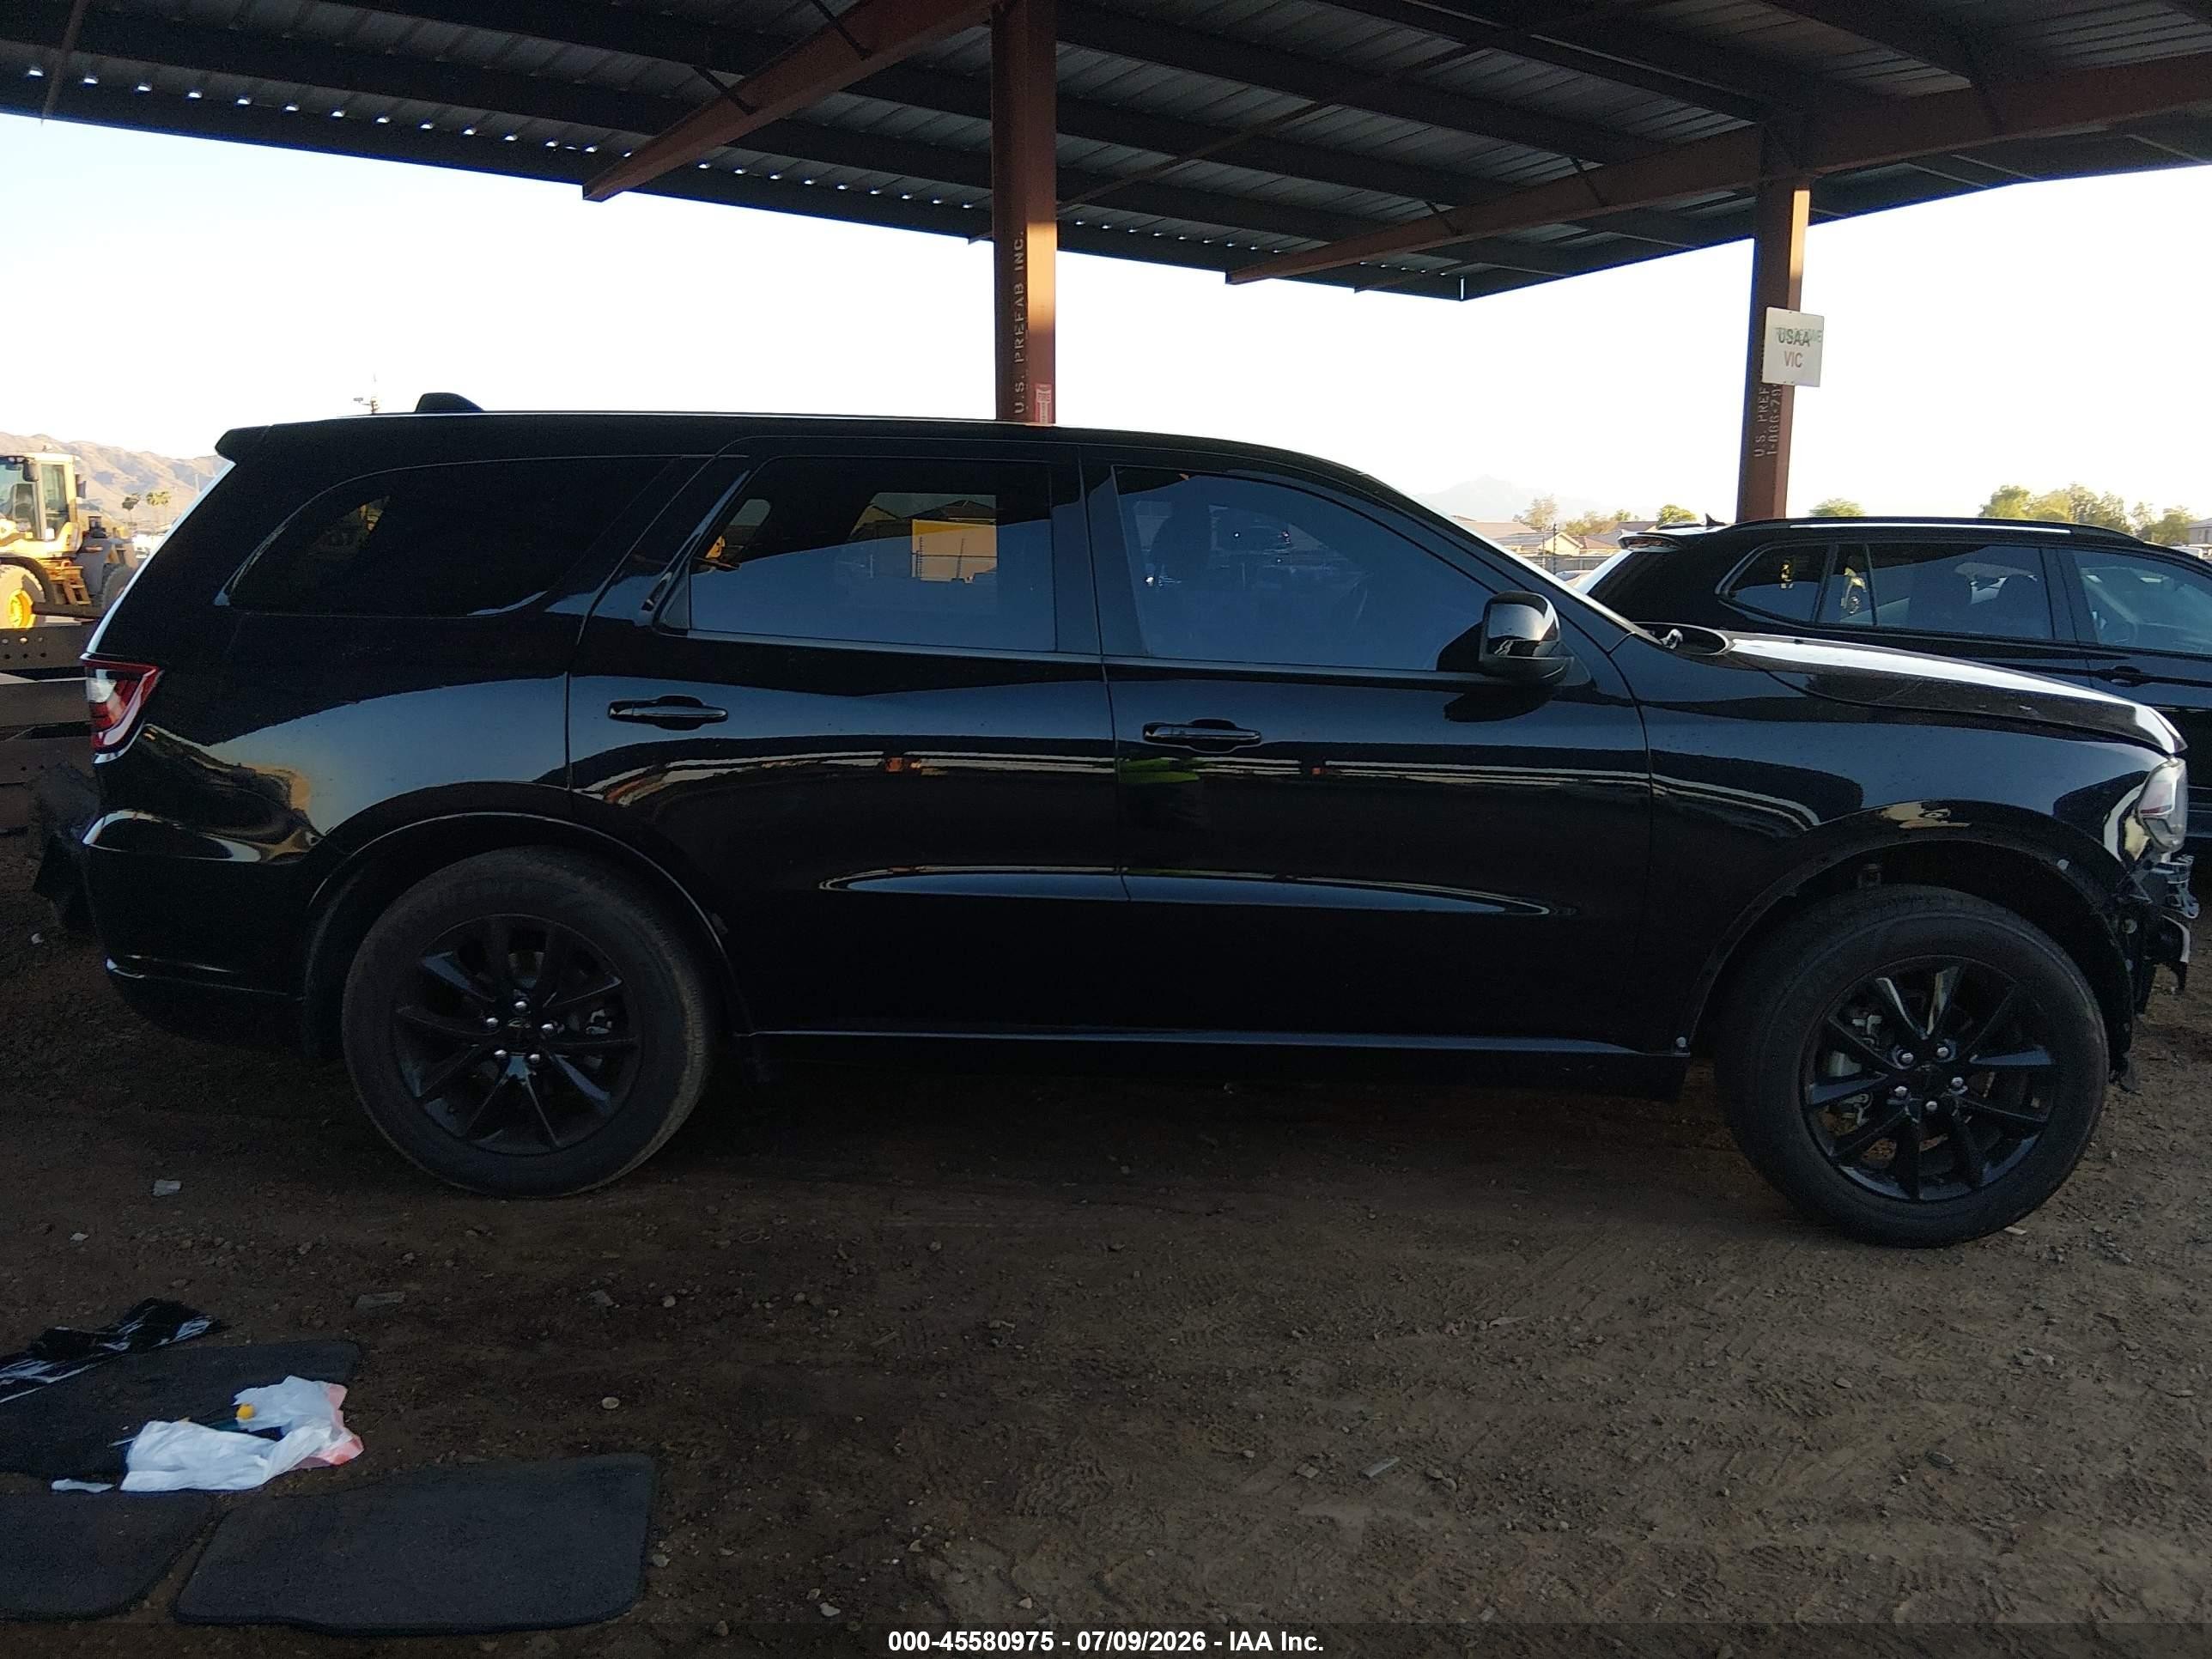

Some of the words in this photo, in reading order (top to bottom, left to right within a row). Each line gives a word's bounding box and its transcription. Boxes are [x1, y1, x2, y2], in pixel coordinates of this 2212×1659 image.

[1014, 231, 1024, 271] INC.
[1014, 283, 1024, 362] PREFAB
[1778, 328, 1810, 347] USAA
[1784, 350, 1802, 368] VIC
[1014, 375, 1024, 414] U.S.
[1757, 386, 1769, 422] PREF
[1766, 385, 1782, 454] 1-866-79
[1753, 431, 1766, 457] U.S.
